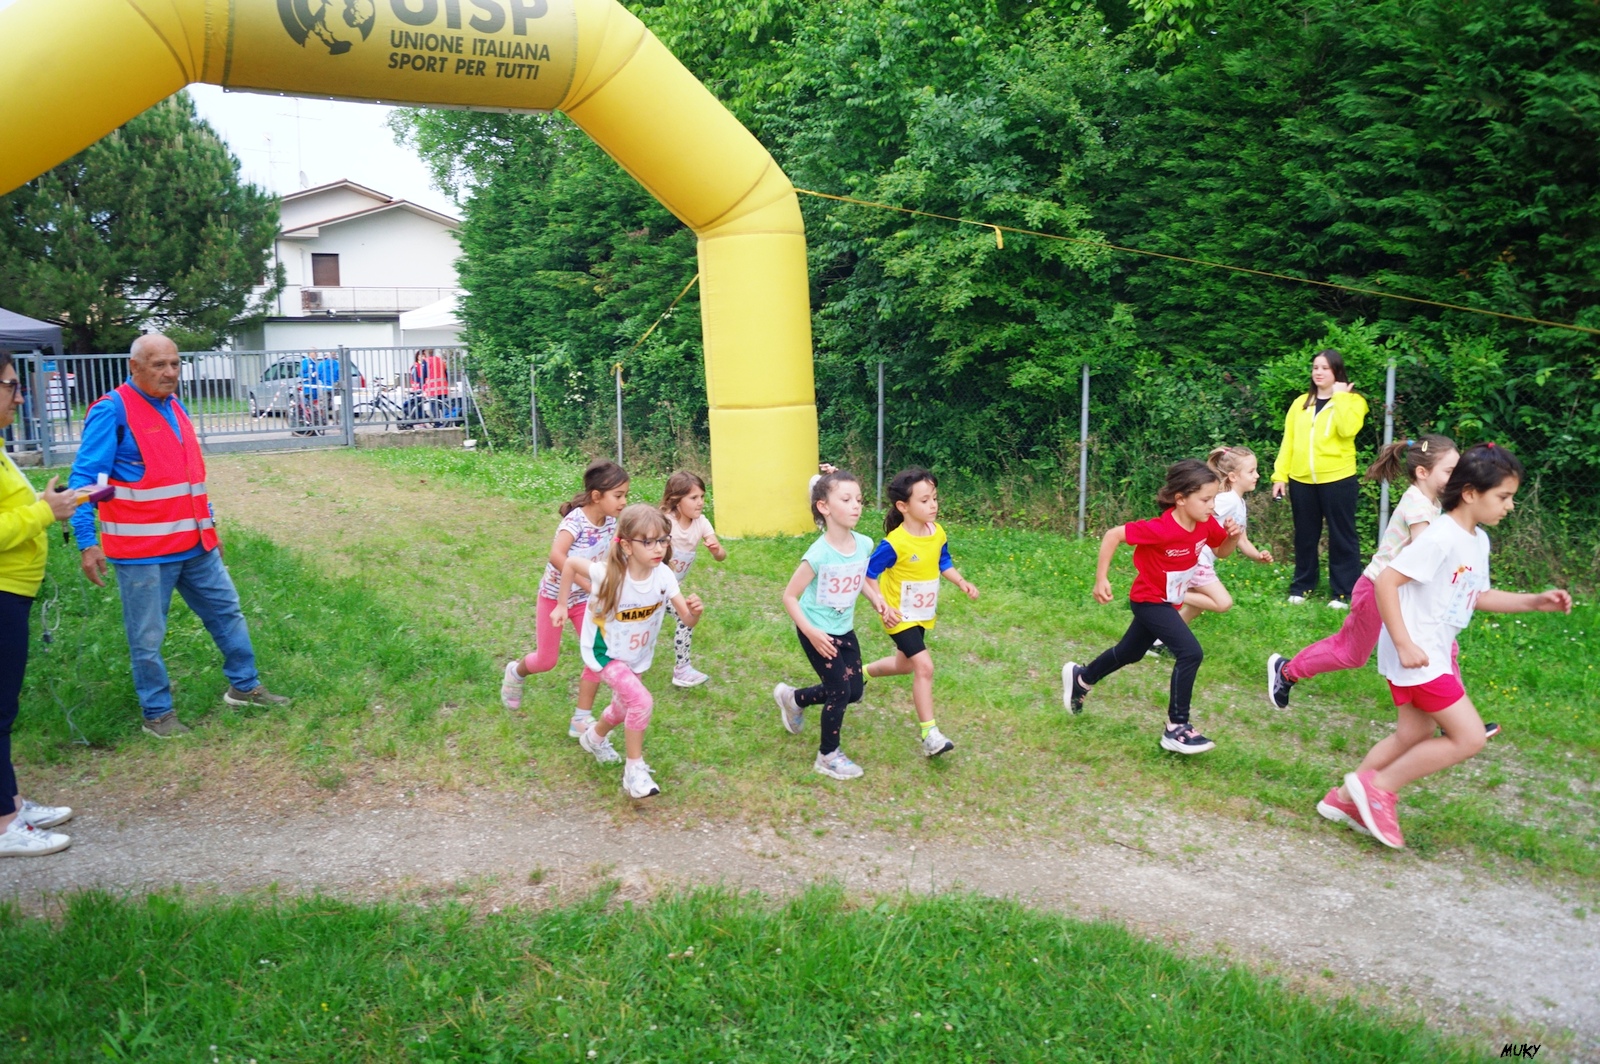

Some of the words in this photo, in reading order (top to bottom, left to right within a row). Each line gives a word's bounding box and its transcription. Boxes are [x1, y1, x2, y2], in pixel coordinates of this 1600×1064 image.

[390, 30, 464, 54] UNIONE
[472, 38, 551, 61] ITALIANA
[388, 52, 448, 73] SPORT
[454, 58, 486, 76] PER
[496, 62, 539, 80] TUTTI
[828, 574, 861, 594] 329
[628, 631, 650, 650] 50
